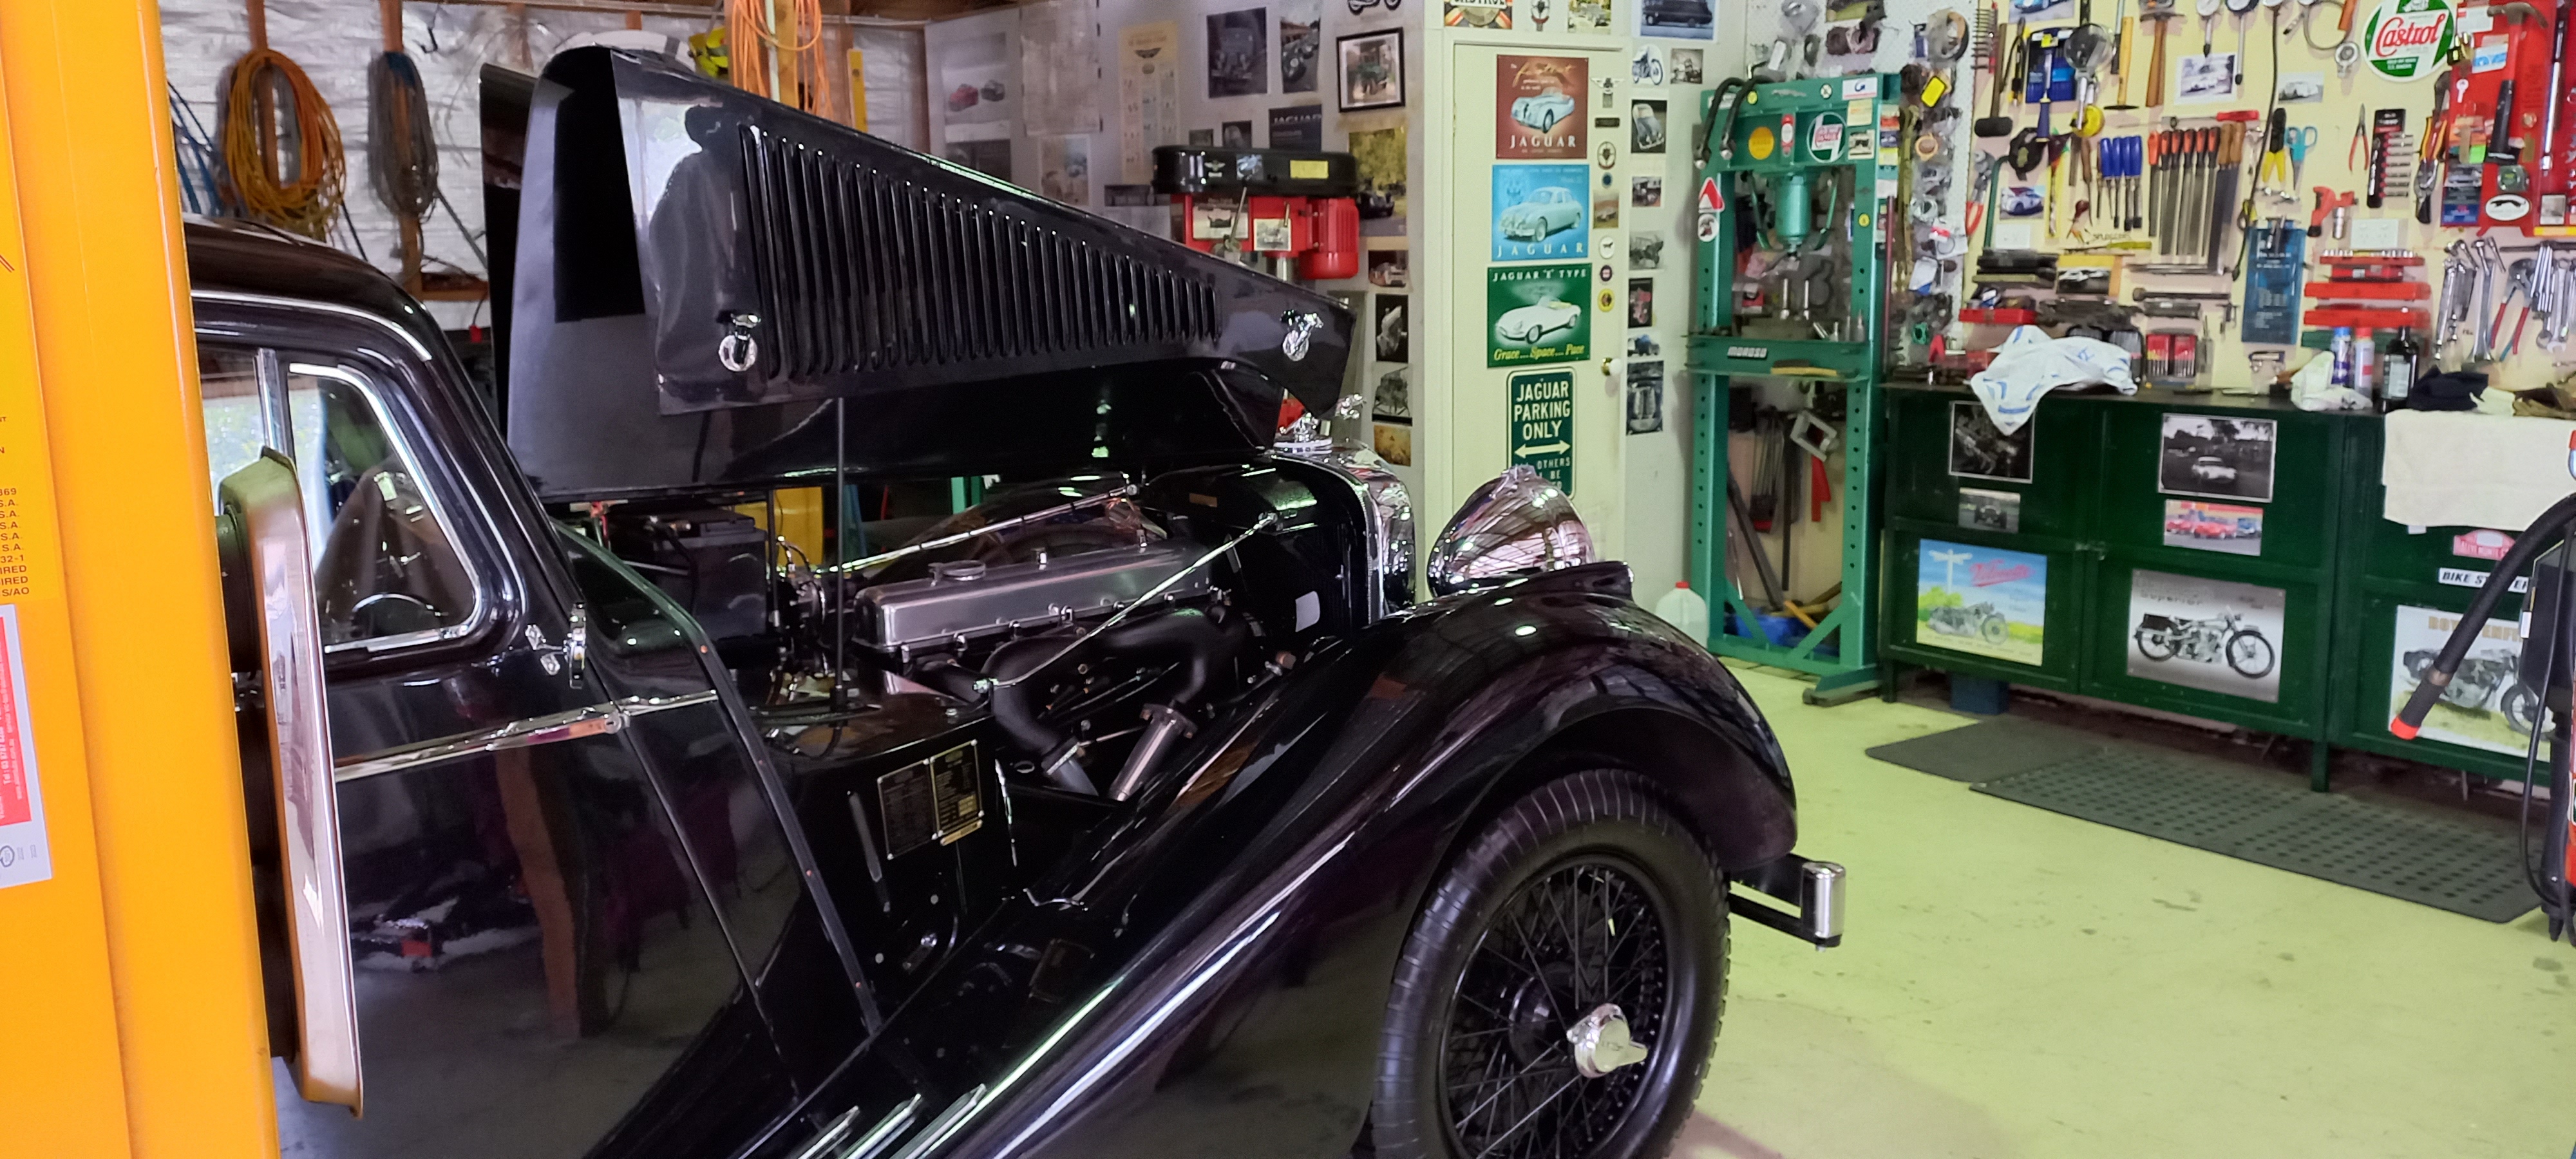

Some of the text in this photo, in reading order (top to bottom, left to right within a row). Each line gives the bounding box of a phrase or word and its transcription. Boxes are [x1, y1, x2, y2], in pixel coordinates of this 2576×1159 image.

[2376, 14, 2446, 57] Castrol
[1510, 135, 1576, 149] JAGUAR
[1497, 242, 1583, 258] JAGUAR
[1493, 270, 1539, 282] JAGUAR
[1559, 269, 1587, 278] TYPE
[1516, 381, 1569, 402] JAGUAR
[1514, 400, 1571, 422] PARKING
[1522, 420, 1562, 440] ONLY
[1537, 457, 1570, 470] OTHERS
[1550, 470, 1561, 480] BE
[2442, 571, 2470, 583] BIKE
[2429, 616, 2460, 632] ROY
